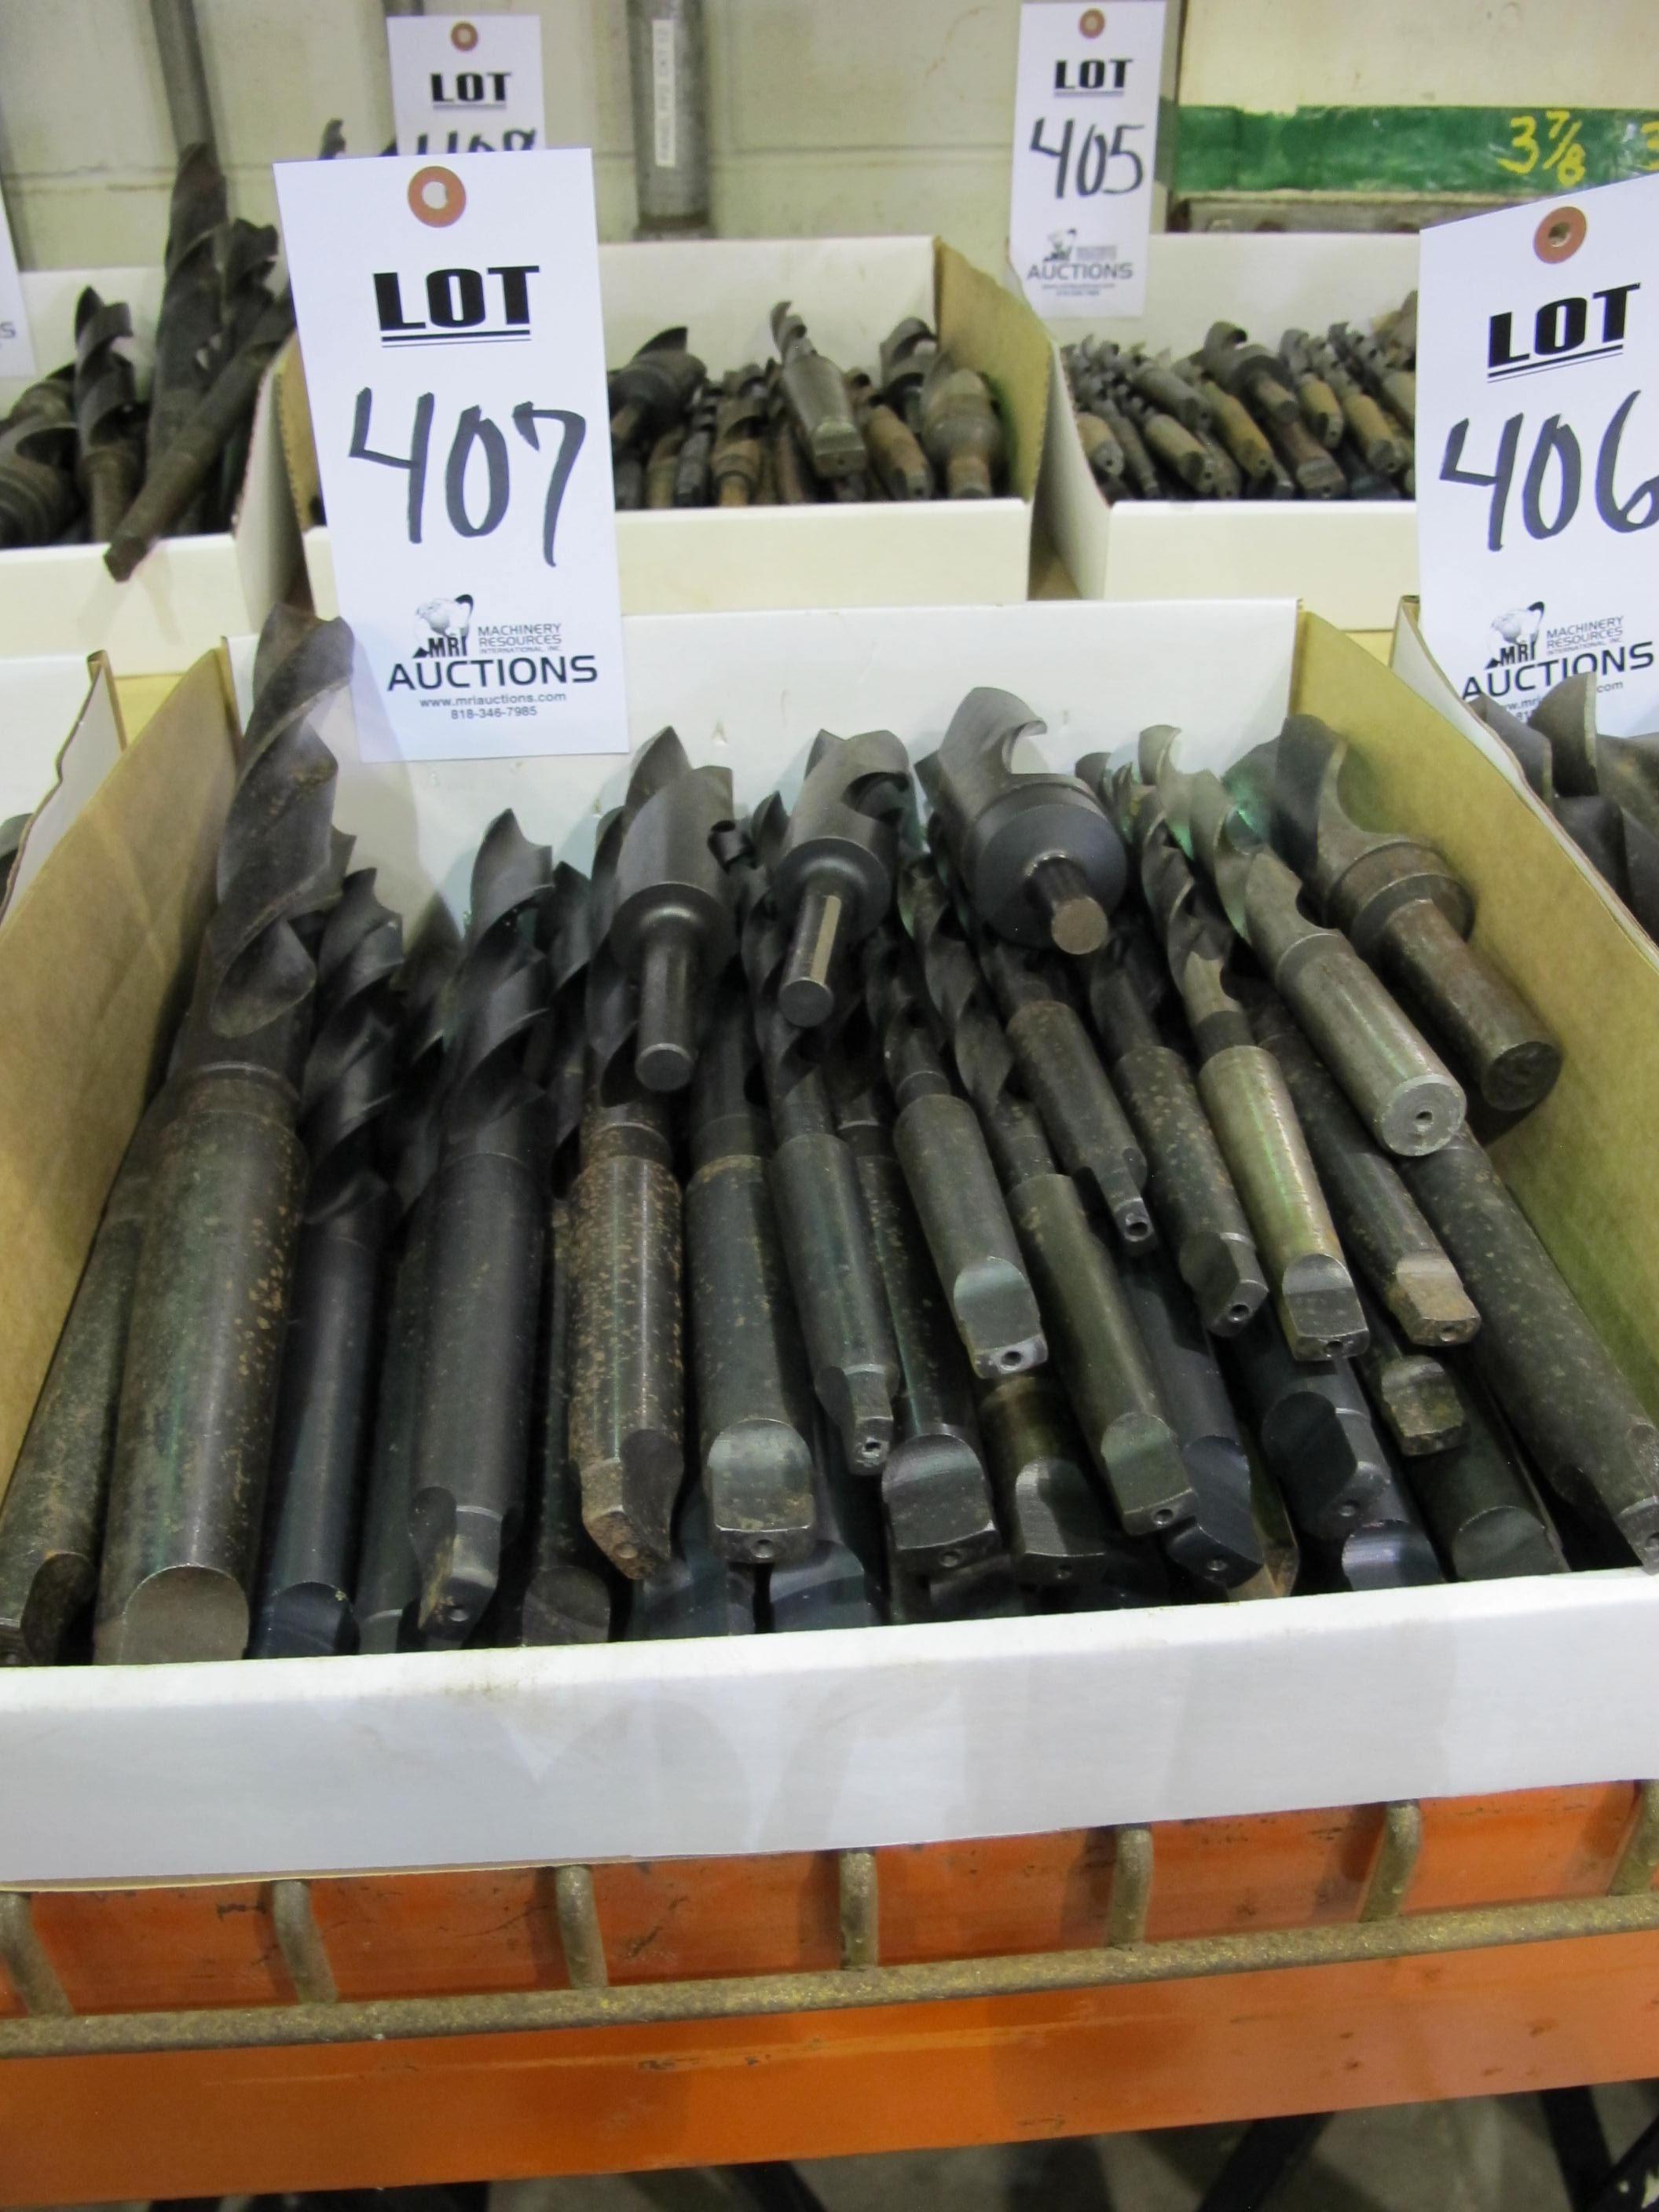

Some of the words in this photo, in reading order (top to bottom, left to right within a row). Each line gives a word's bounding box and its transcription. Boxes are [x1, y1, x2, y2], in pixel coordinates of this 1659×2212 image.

[430, 71, 512, 101] LOT
[1054, 59, 1133, 89] LOT
[1030, 117, 1145, 199] 405
[1026, 262, 1133, 280] AUCTIONS
[372, 266, 540, 331] LOT
[1487, 283, 1641, 368] LOT
[348, 386, 586, 567] 407
[1439, 390, 1659, 551] 406
[478, 623, 562, 636] MACHINERY
[478, 635, 562, 647] RESOURCES
[1547, 616, 1624, 639] MACHINERY
[1547, 628, 1623, 649] RESOURCES
[428, 635, 468, 657] MRI
[1500, 641, 1536, 666] MRI
[387, 655, 598, 691] AUCTIONS
[1463, 641, 1654, 701] AUCTIONS
[419, 692, 566, 708] www.mriauctions.com
[451, 705, 537, 720] 818-346-7985
